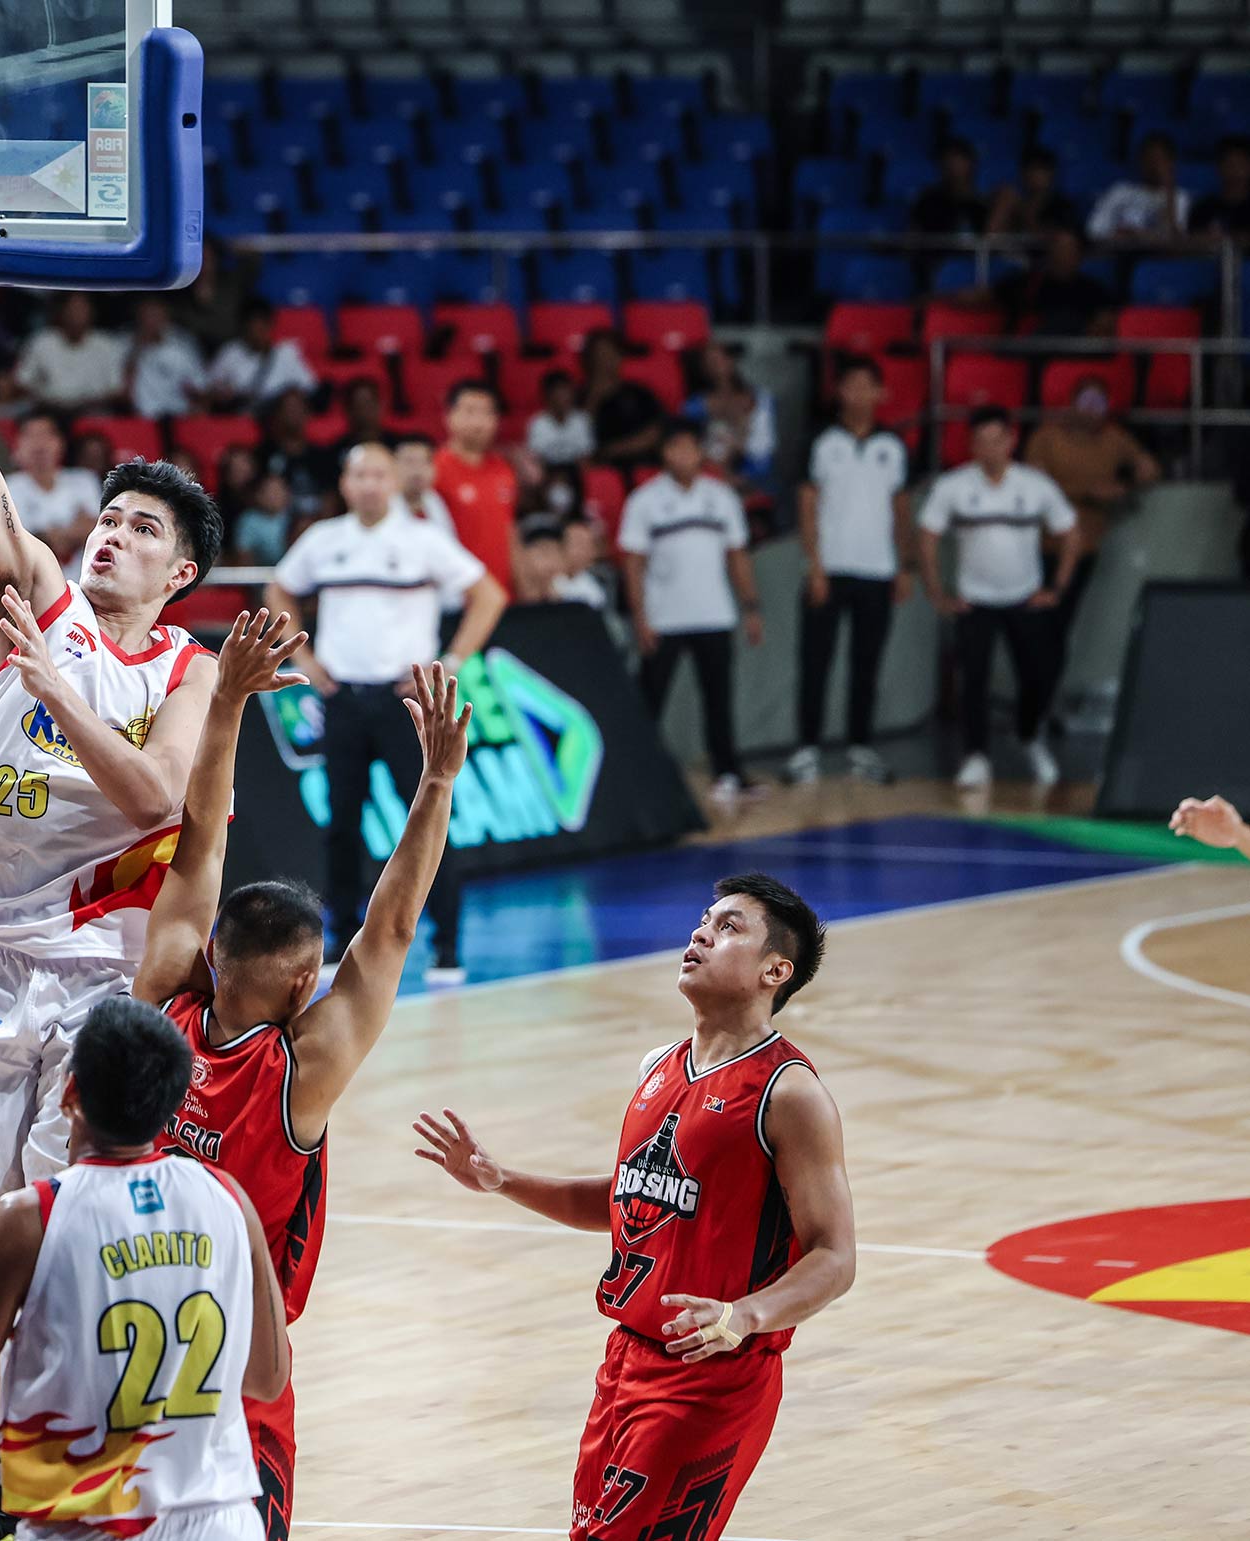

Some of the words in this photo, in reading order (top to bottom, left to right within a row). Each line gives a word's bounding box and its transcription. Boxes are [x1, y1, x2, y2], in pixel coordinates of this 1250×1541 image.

[65, 629, 86, 647] ANTA
[52, 746, 79, 762] ELA
[163, 1114, 223, 1162] ASIO
[99, 1230, 212, 1280] CLARITO
[600, 1247, 656, 1309] 27
[97, 1290, 227, 1434] 22
